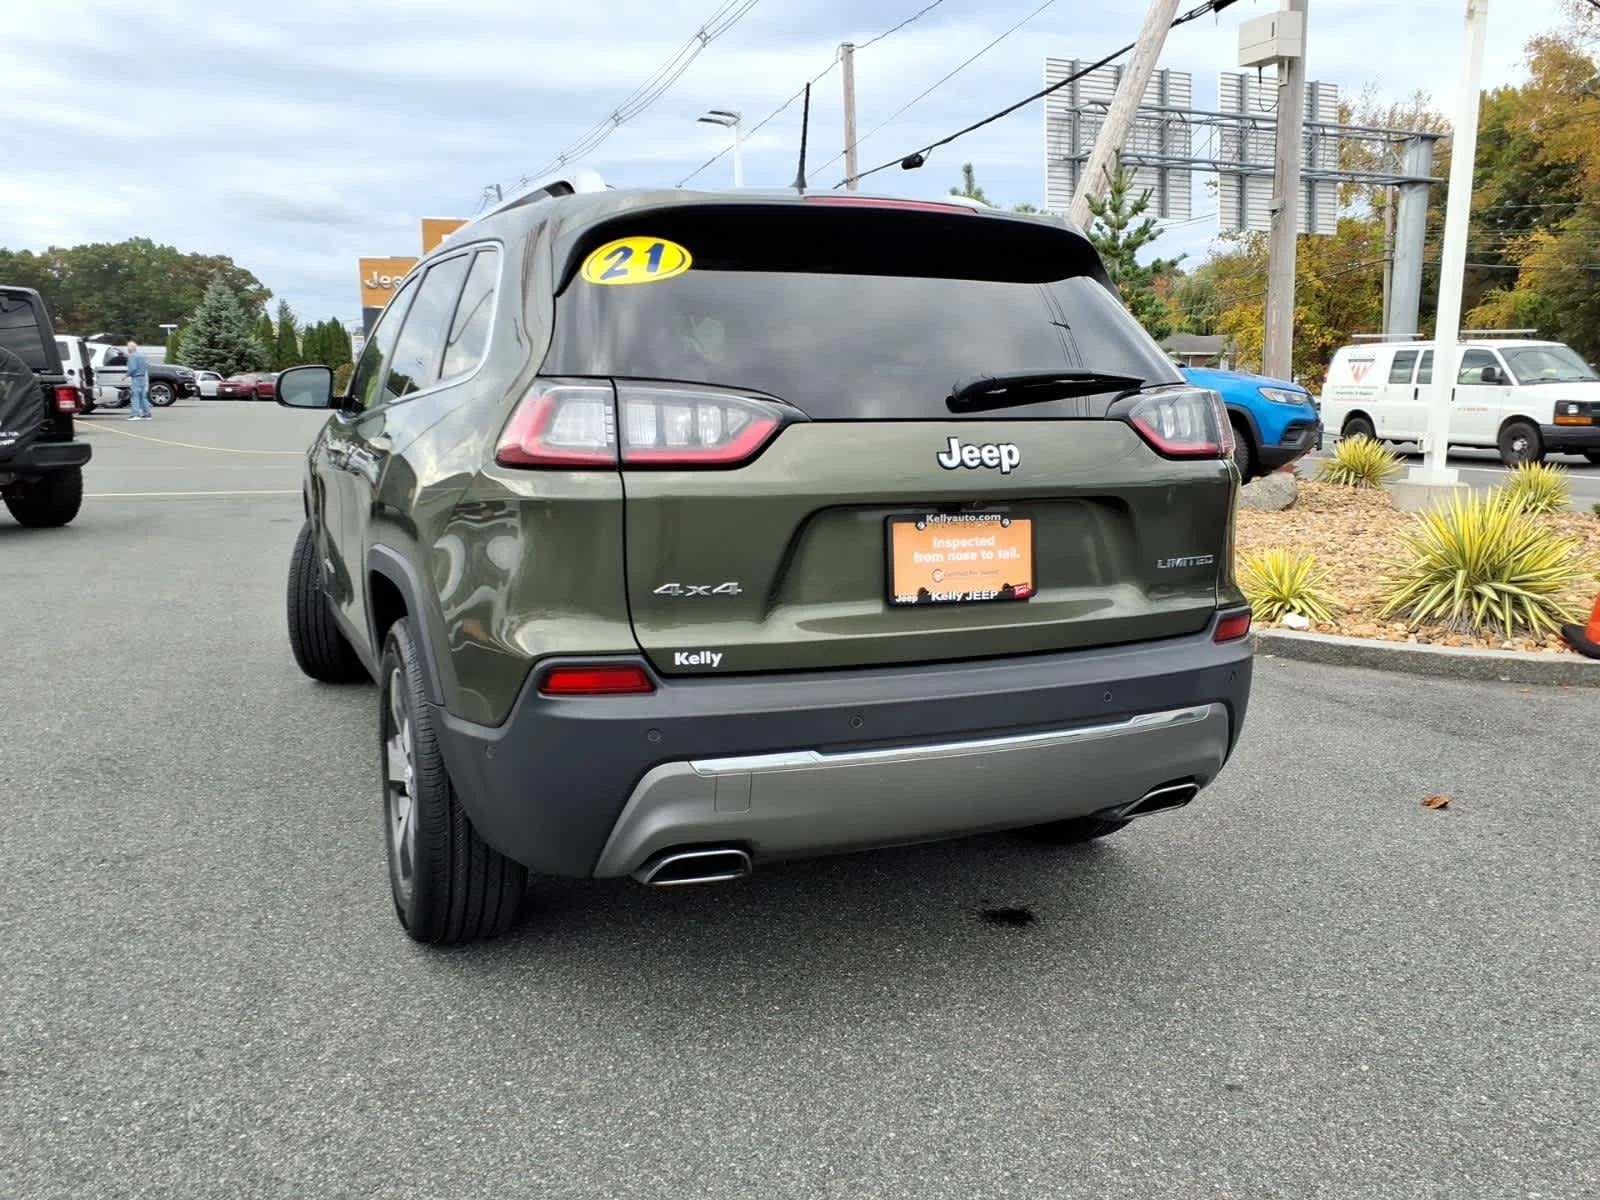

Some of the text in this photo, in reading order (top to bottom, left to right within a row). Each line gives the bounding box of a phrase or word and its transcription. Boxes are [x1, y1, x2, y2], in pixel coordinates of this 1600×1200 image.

[600, 242, 665, 280] 21
[364, 271, 403, 289] Jee
[936, 436, 1021, 475] Jeep
[925, 513, 1001, 524] Kellyauto.com
[933, 536, 996, 550] Inspected
[914, 552, 944, 563] from
[981, 549, 994, 560] to
[1157, 554, 1214, 569] LIMITED
[653, 582, 743, 596] 4x4
[930, 590, 999, 602] Kelly JEEP
[674, 650, 723, 667] Kelly
